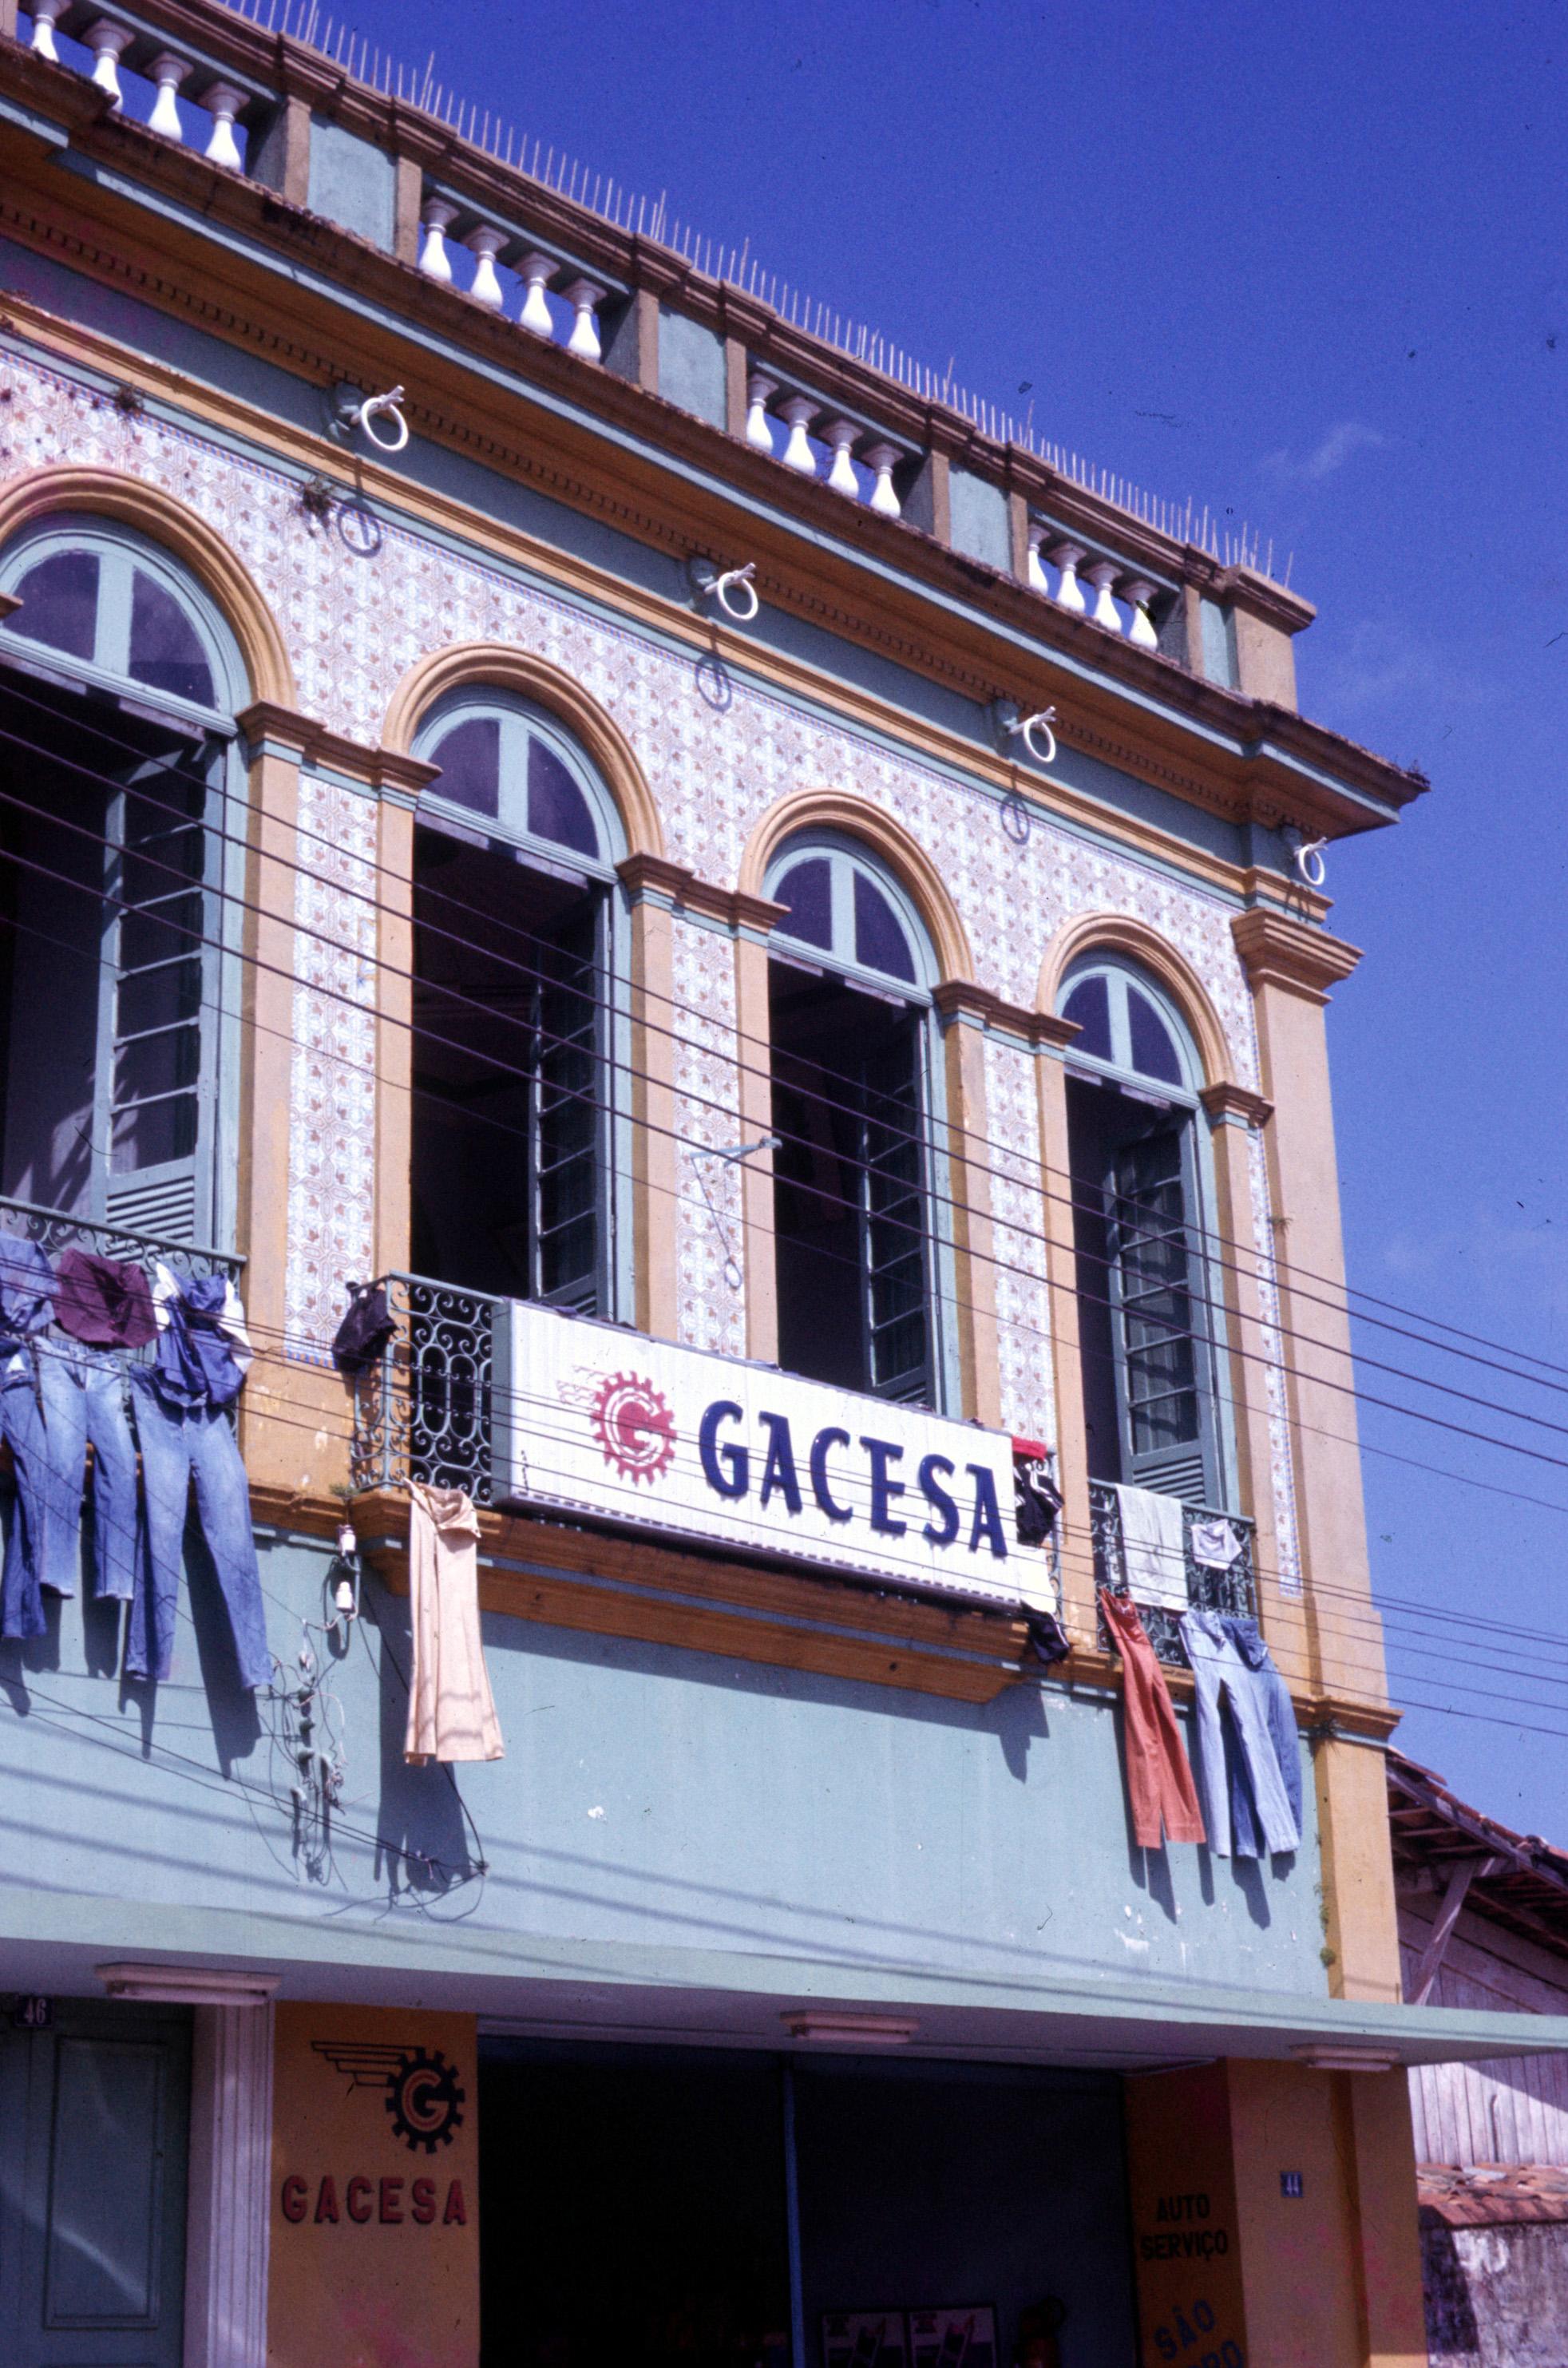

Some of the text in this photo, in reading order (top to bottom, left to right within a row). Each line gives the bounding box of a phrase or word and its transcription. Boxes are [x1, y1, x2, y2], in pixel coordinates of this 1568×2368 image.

[699, 1400, 1008, 1558] GACESA
[24, 1998, 47, 2024] 46
[402, 2068, 449, 2132] G
[281, 2175, 468, 2226] GACESA
[1157, 2193, 1210, 2222] AUTO
[1140, 2230, 1229, 2261] SERVIÇO
